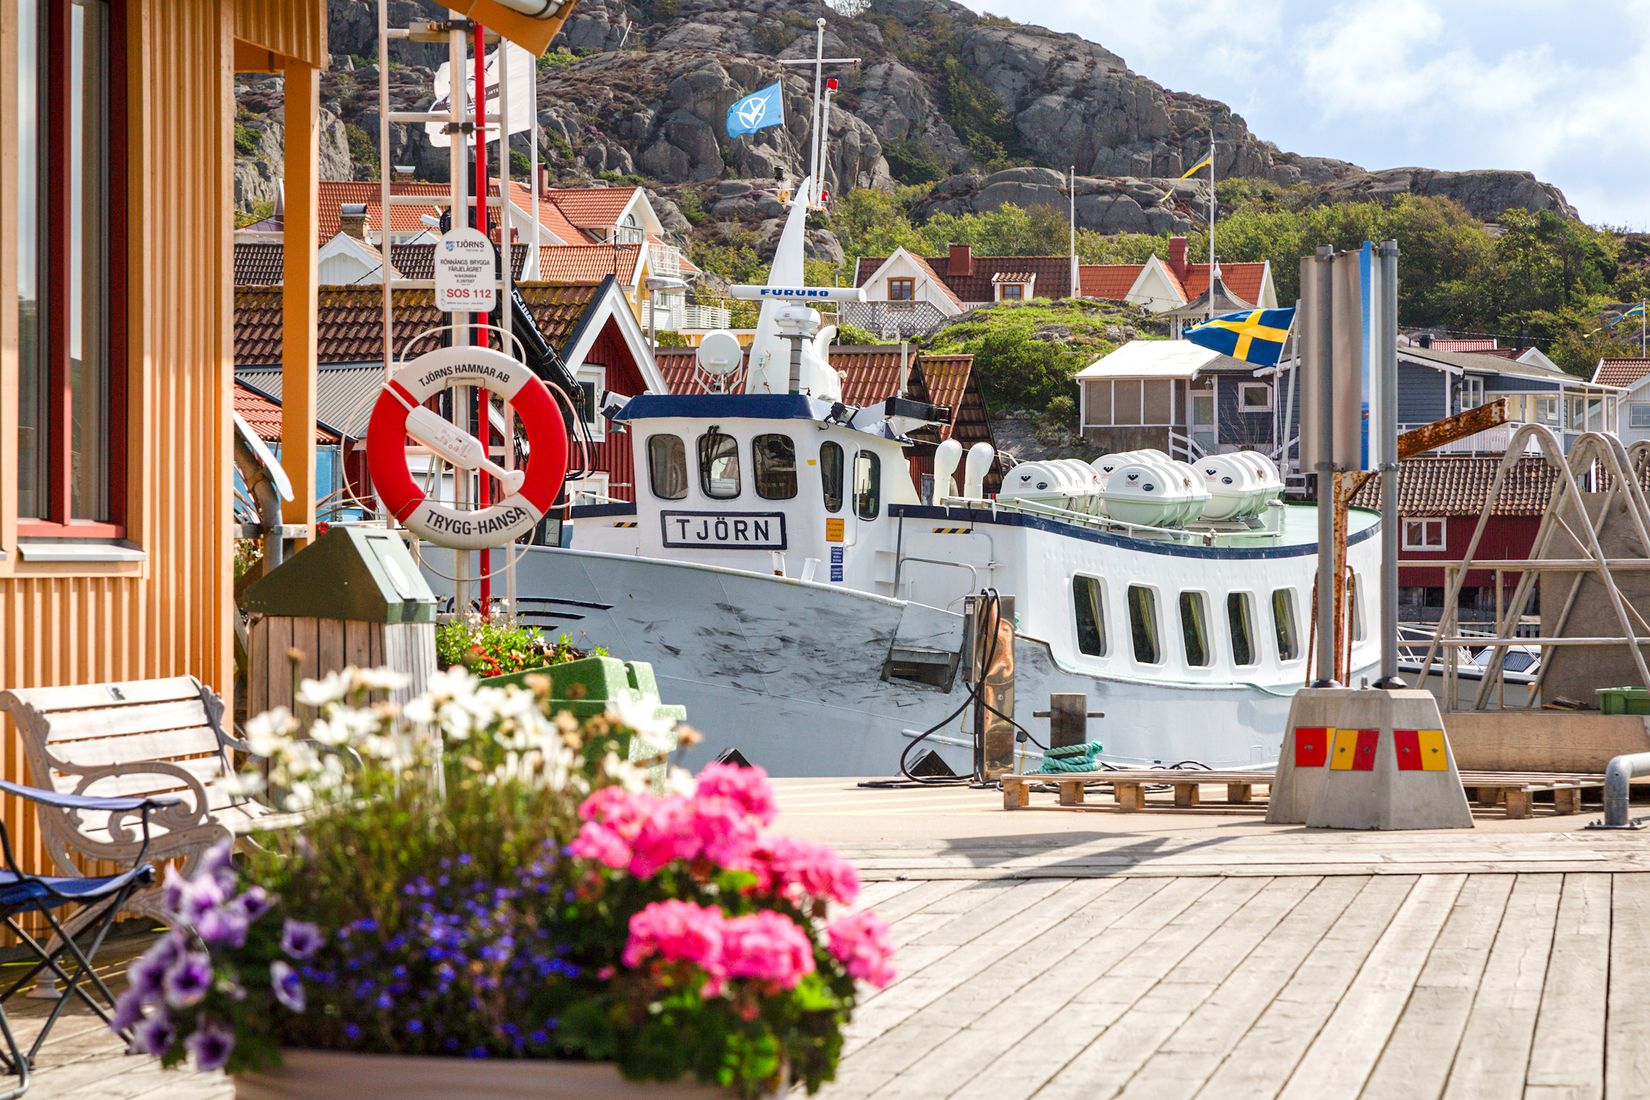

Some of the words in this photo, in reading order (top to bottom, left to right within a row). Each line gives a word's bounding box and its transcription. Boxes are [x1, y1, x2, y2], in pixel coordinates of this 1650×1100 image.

[456, 240, 485, 248] TJÖRNS
[446, 288, 469, 298] SOS
[473, 289, 491, 298] 112
[761, 289, 828, 297] FURUNO
[419, 366, 453, 386] TJÖRNS
[455, 364, 496, 376] HAMNAR
[496, 371, 511, 383] AB
[427, 507, 526, 534] TRYGG-HANSA
[677, 517, 769, 541] TJÖRN
